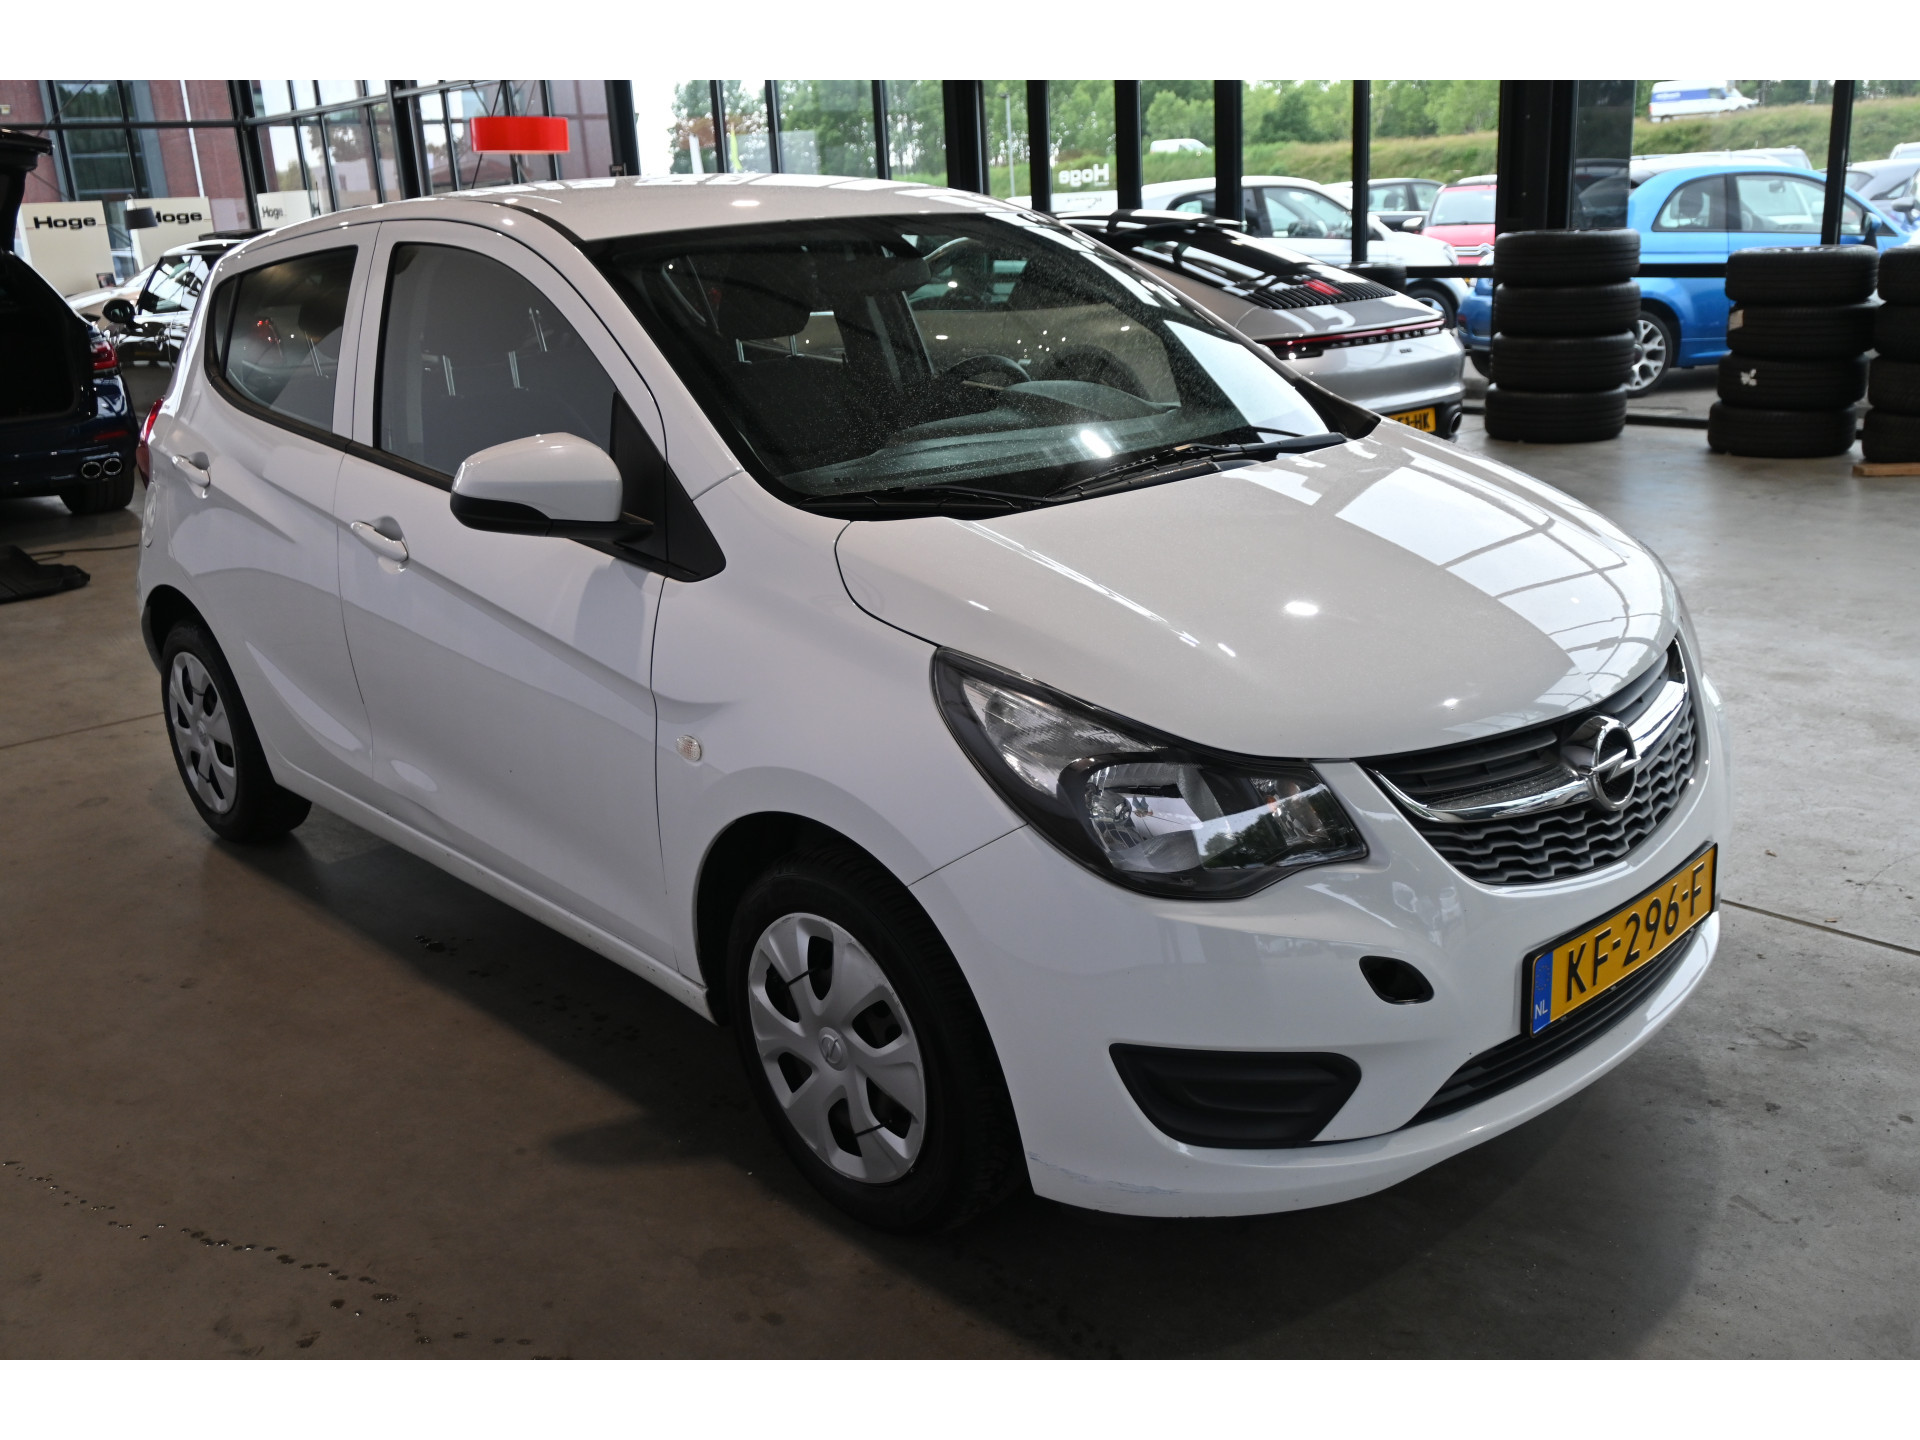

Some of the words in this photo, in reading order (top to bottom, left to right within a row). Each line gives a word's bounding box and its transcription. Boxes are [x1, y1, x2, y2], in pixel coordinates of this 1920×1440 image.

[33, 215, 97, 230] Hoge
[1566, 861, 1705, 1003] KF-296-F
[1534, 999, 1549, 1020] NL
